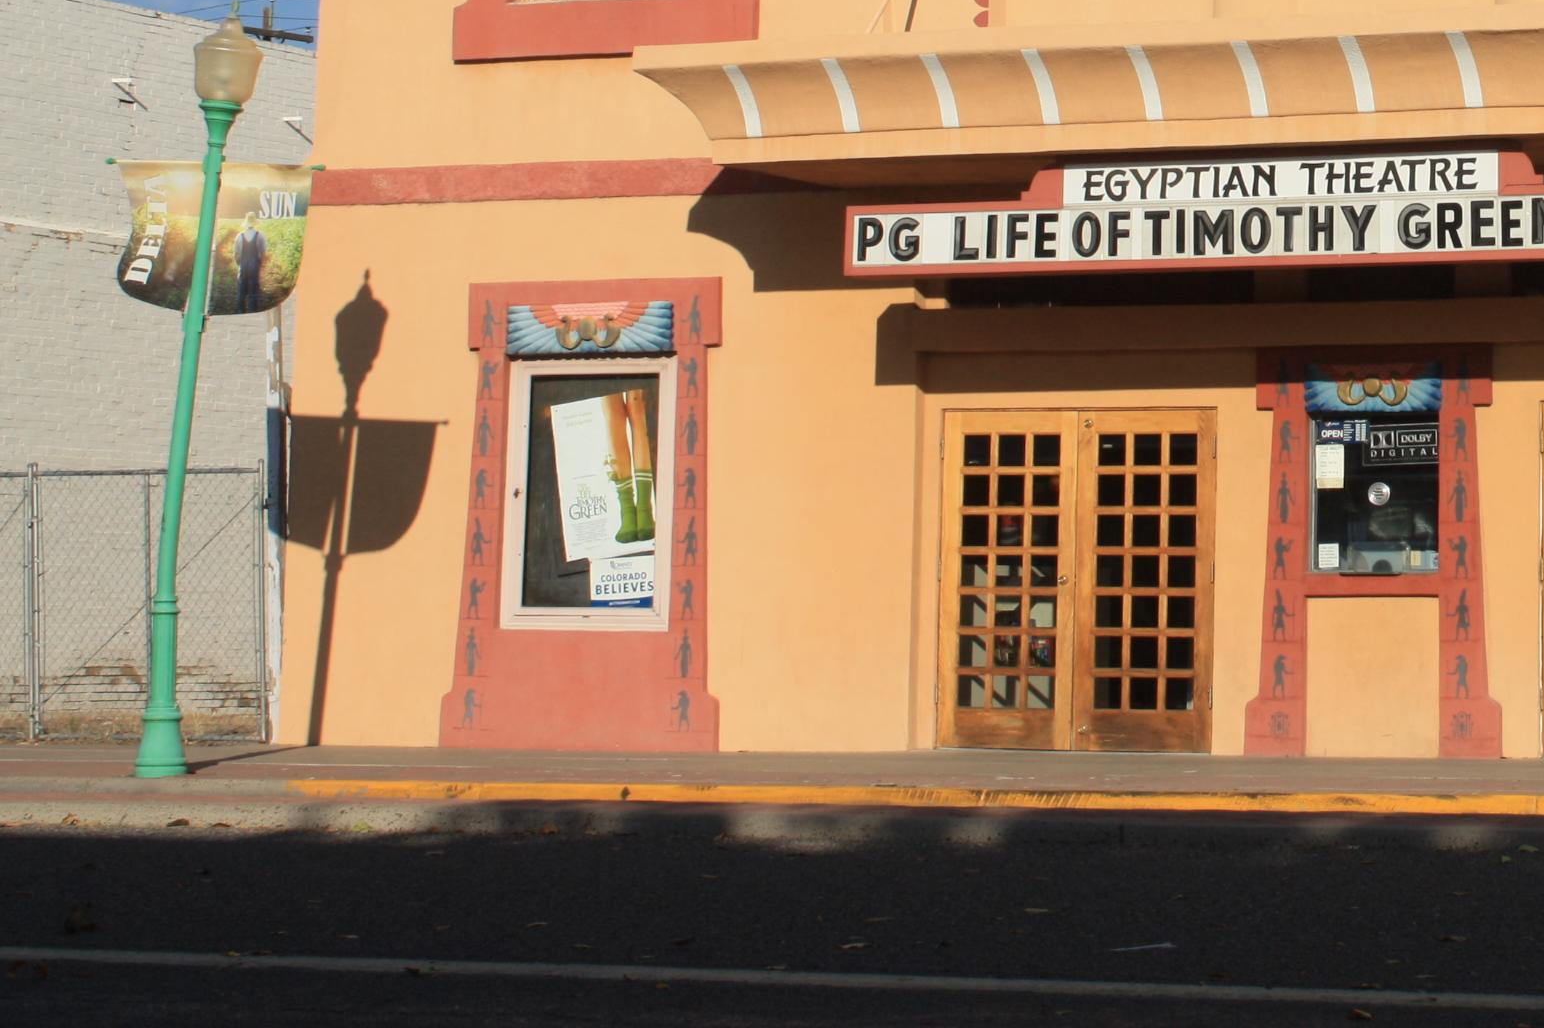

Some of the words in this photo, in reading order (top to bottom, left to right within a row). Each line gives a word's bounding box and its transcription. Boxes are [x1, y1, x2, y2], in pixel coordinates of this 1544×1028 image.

[1082, 164, 1278, 203] EGYPTIAN
[1299, 156, 1479, 195] THEATRE
[258, 190, 297, 220] SUN
[123, 174, 168, 285] DELTA
[856, 216, 921, 263] PG
[952, 213, 1059, 262] LIFE
[1071, 210, 1132, 259] OF
[1143, 204, 1378, 257] TIMOTHY
[1321, 429, 1344, 438] OPEN
[1400, 433, 1433, 444] DOLBY
[1370, 447, 1438, 459] DIGITAL
[568, 503, 608, 521] GREEN
[600, 571, 648, 583] COLORADO
[595, 580, 655, 596] BELIEVES
